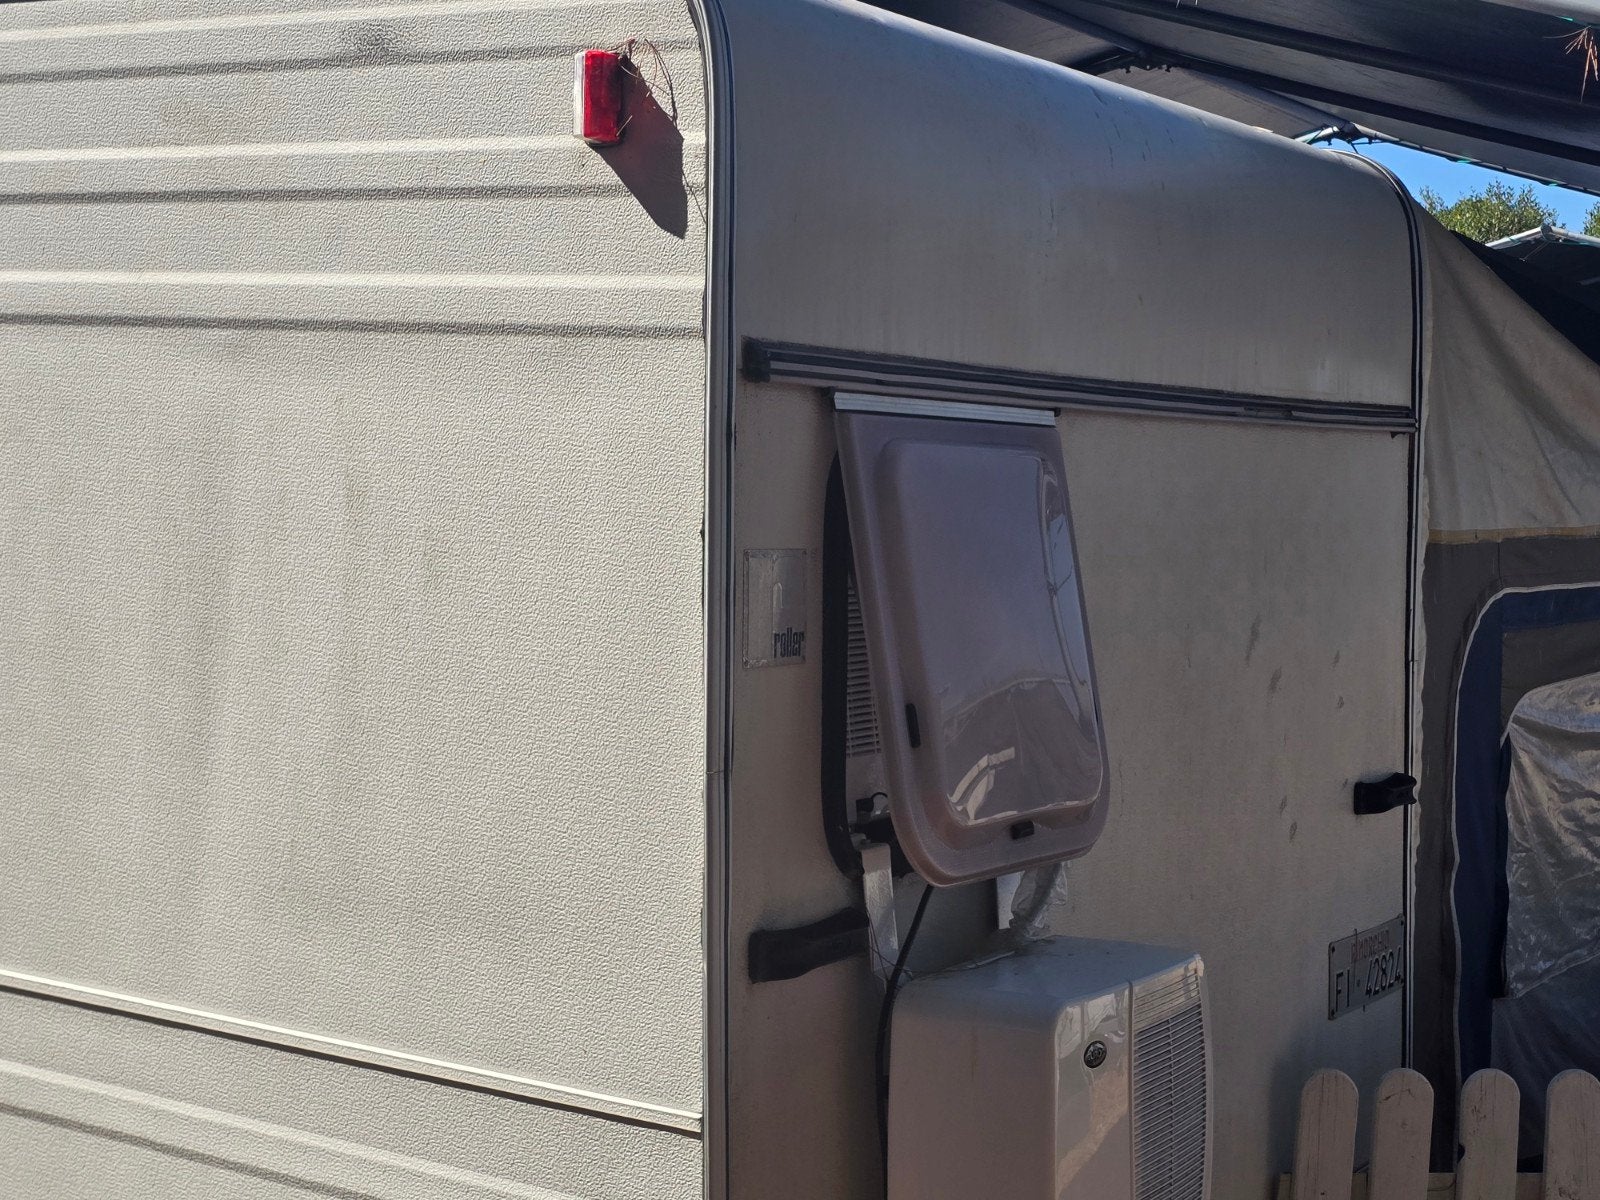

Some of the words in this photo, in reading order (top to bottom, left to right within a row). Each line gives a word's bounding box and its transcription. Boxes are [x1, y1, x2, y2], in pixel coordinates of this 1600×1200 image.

[774, 627, 805, 658] roller
[1336, 968, 1350, 1012] FI
[1365, 946, 1402, 997] 42824
